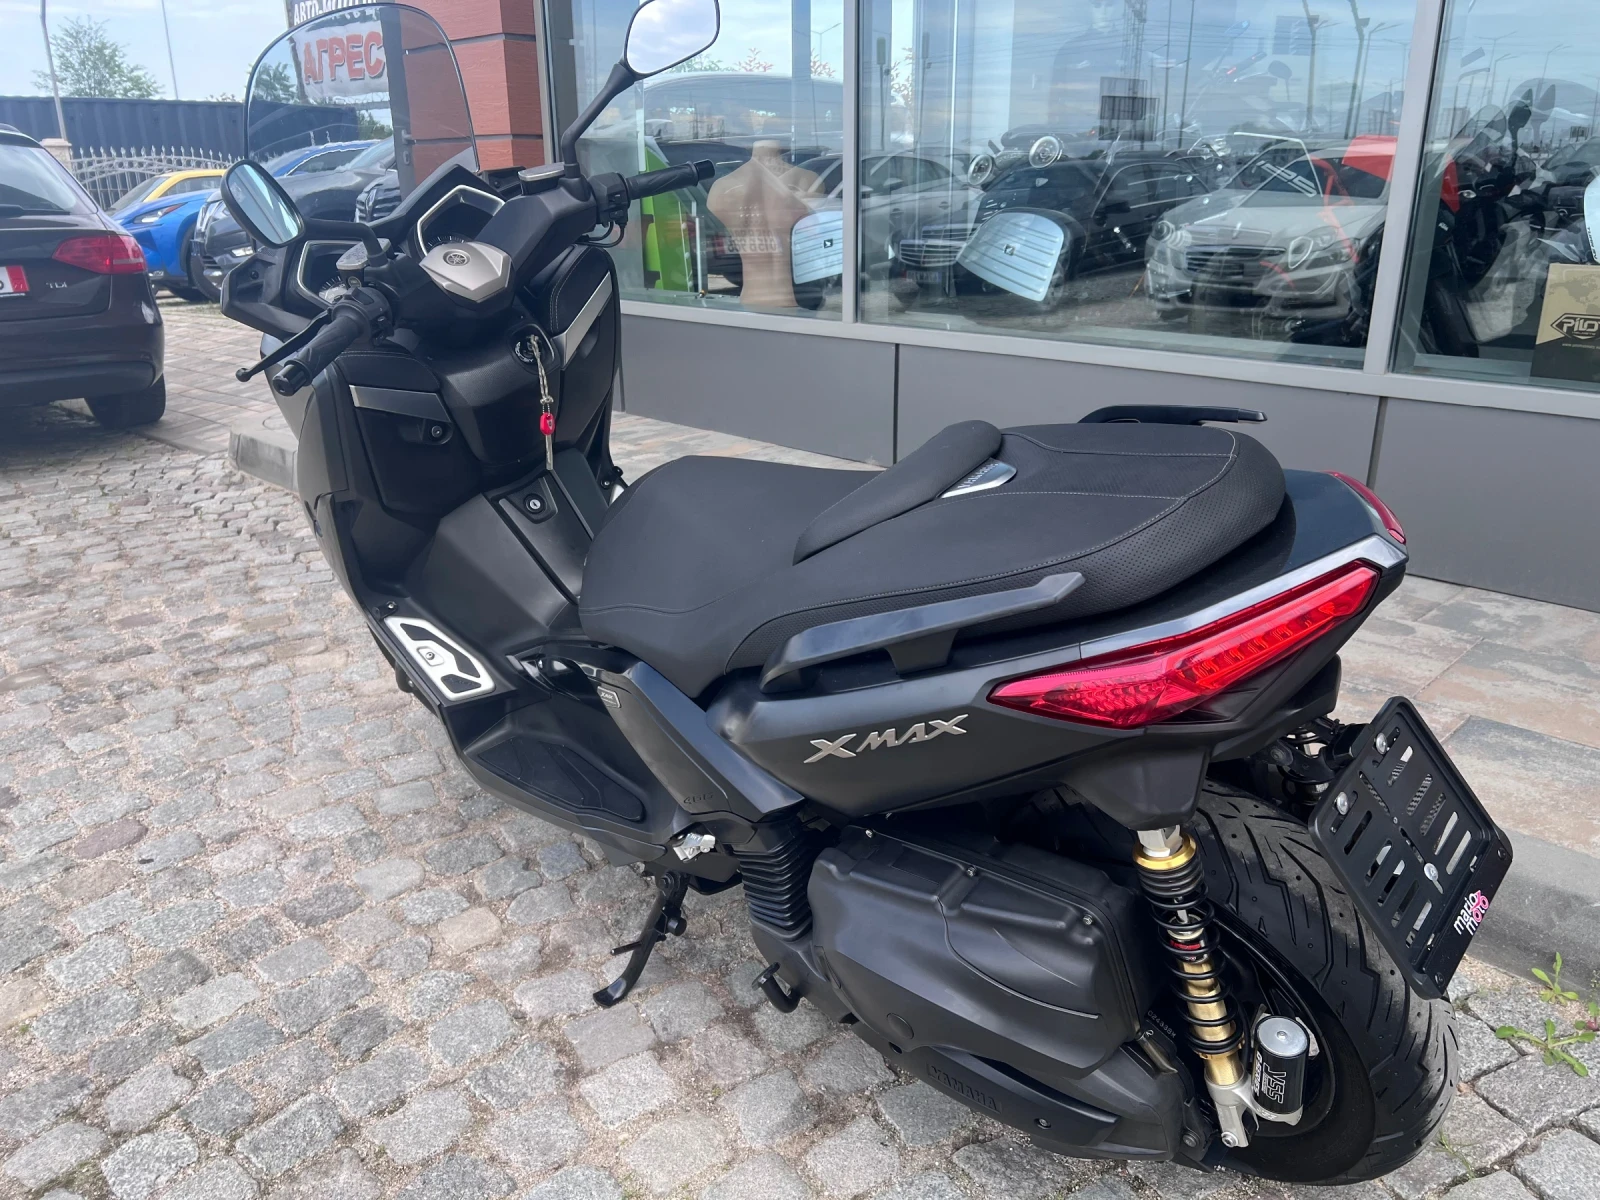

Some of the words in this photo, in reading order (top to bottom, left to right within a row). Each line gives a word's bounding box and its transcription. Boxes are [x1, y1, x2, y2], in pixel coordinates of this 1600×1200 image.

[303, 31, 385, 84] АГРЕС
[1453, 892, 1478, 935] mario
[1465, 895, 1490, 936] moto
[930, 1064, 998, 1111] YAMAHA
[1262, 1062, 1287, 1105] YSS
